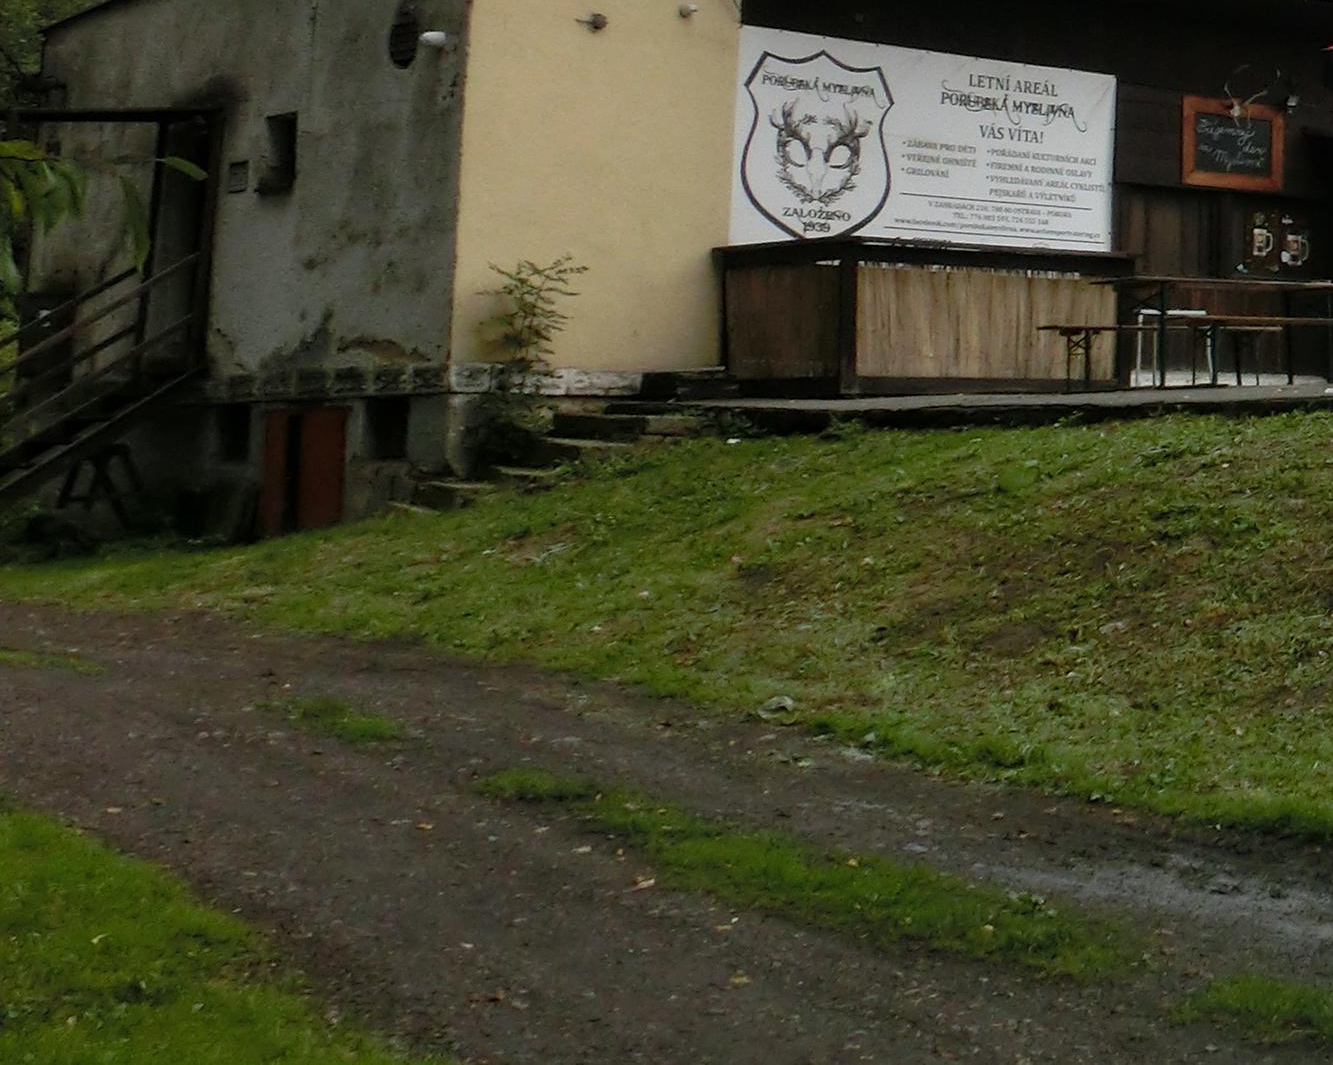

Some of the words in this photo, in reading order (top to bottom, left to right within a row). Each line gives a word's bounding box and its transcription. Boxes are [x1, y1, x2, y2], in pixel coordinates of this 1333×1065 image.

[968, 73, 1011, 91] LETNÍ
[1013, 79, 1058, 97] AREÁL
[978, 122, 1004, 140] VÁS
[1008, 126, 1044, 144] VÍTA!
[781, 206, 851, 223] ZALOŽENO
[803, 221, 831, 233] 1939
